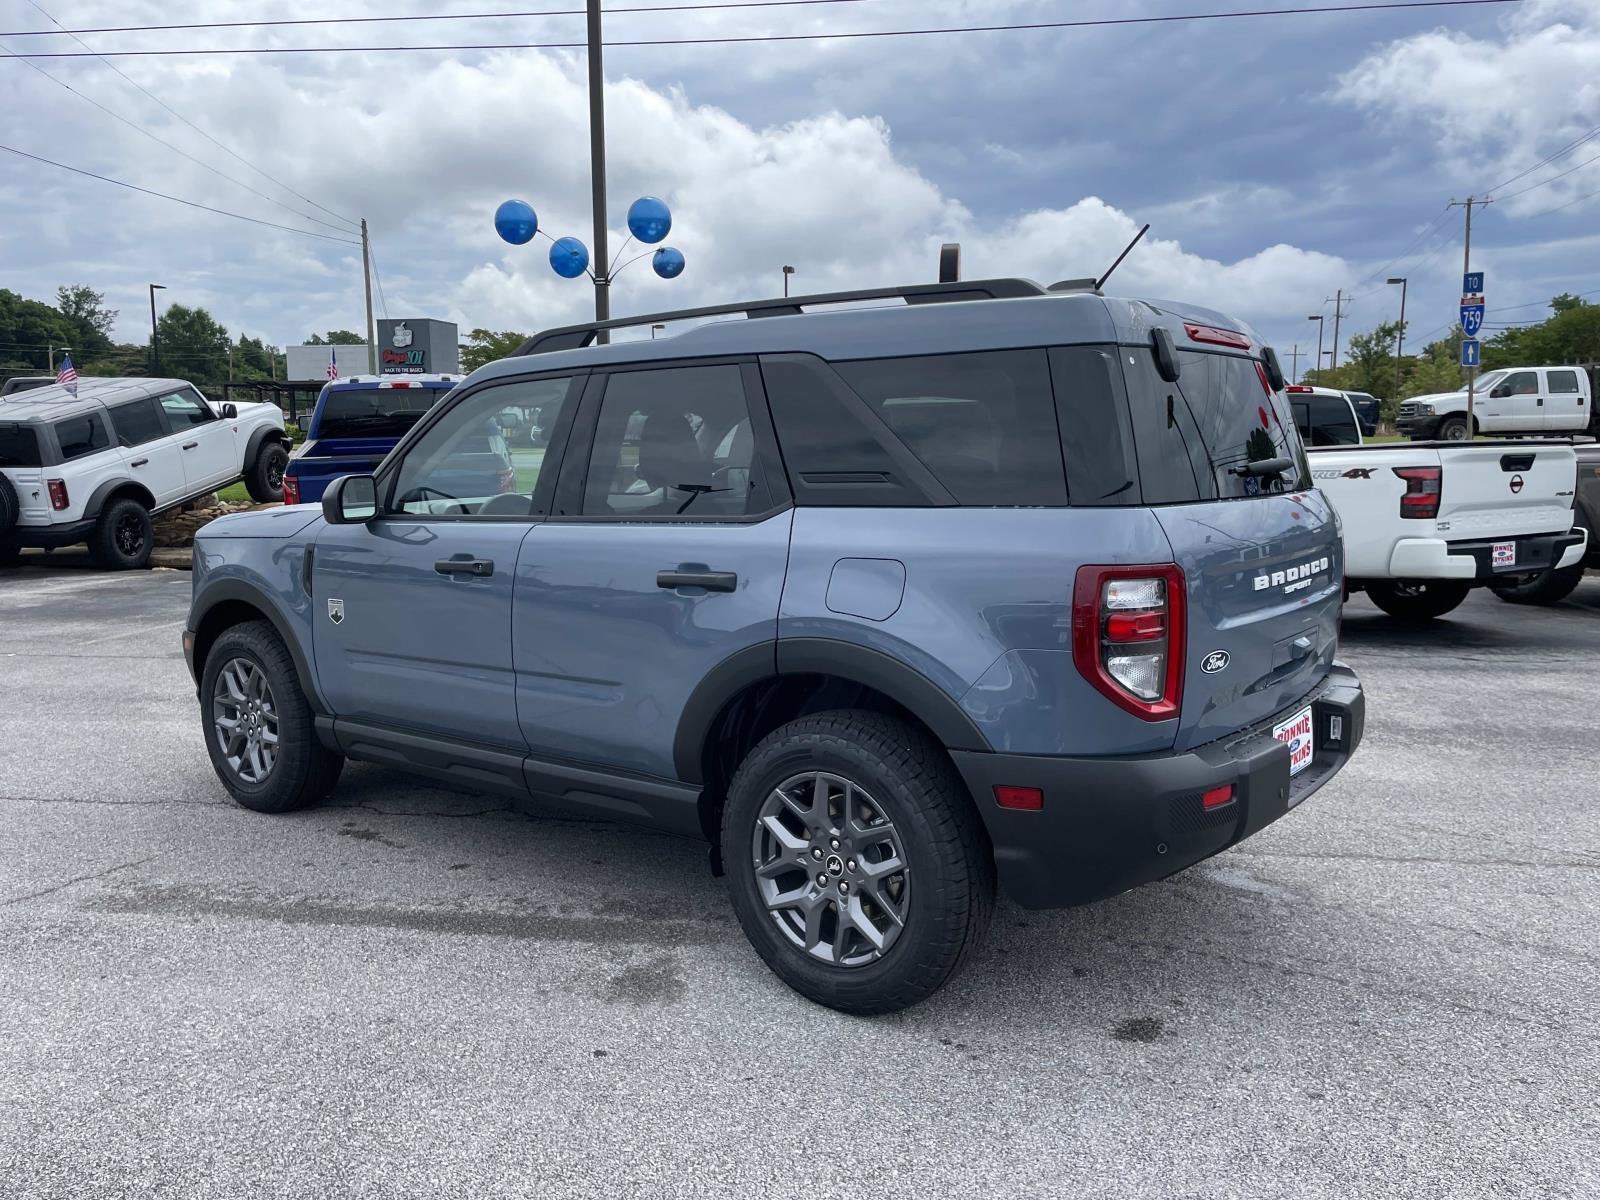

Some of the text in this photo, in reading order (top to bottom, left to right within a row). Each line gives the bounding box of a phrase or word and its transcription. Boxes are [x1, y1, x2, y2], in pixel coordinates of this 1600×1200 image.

[1468, 277, 1479, 289] TO
[1463, 310, 1480, 330] 759
[1253, 557, 1329, 591] BRONCO
[1284, 578, 1312, 594] SPORT
[1206, 653, 1226, 671] Ford
